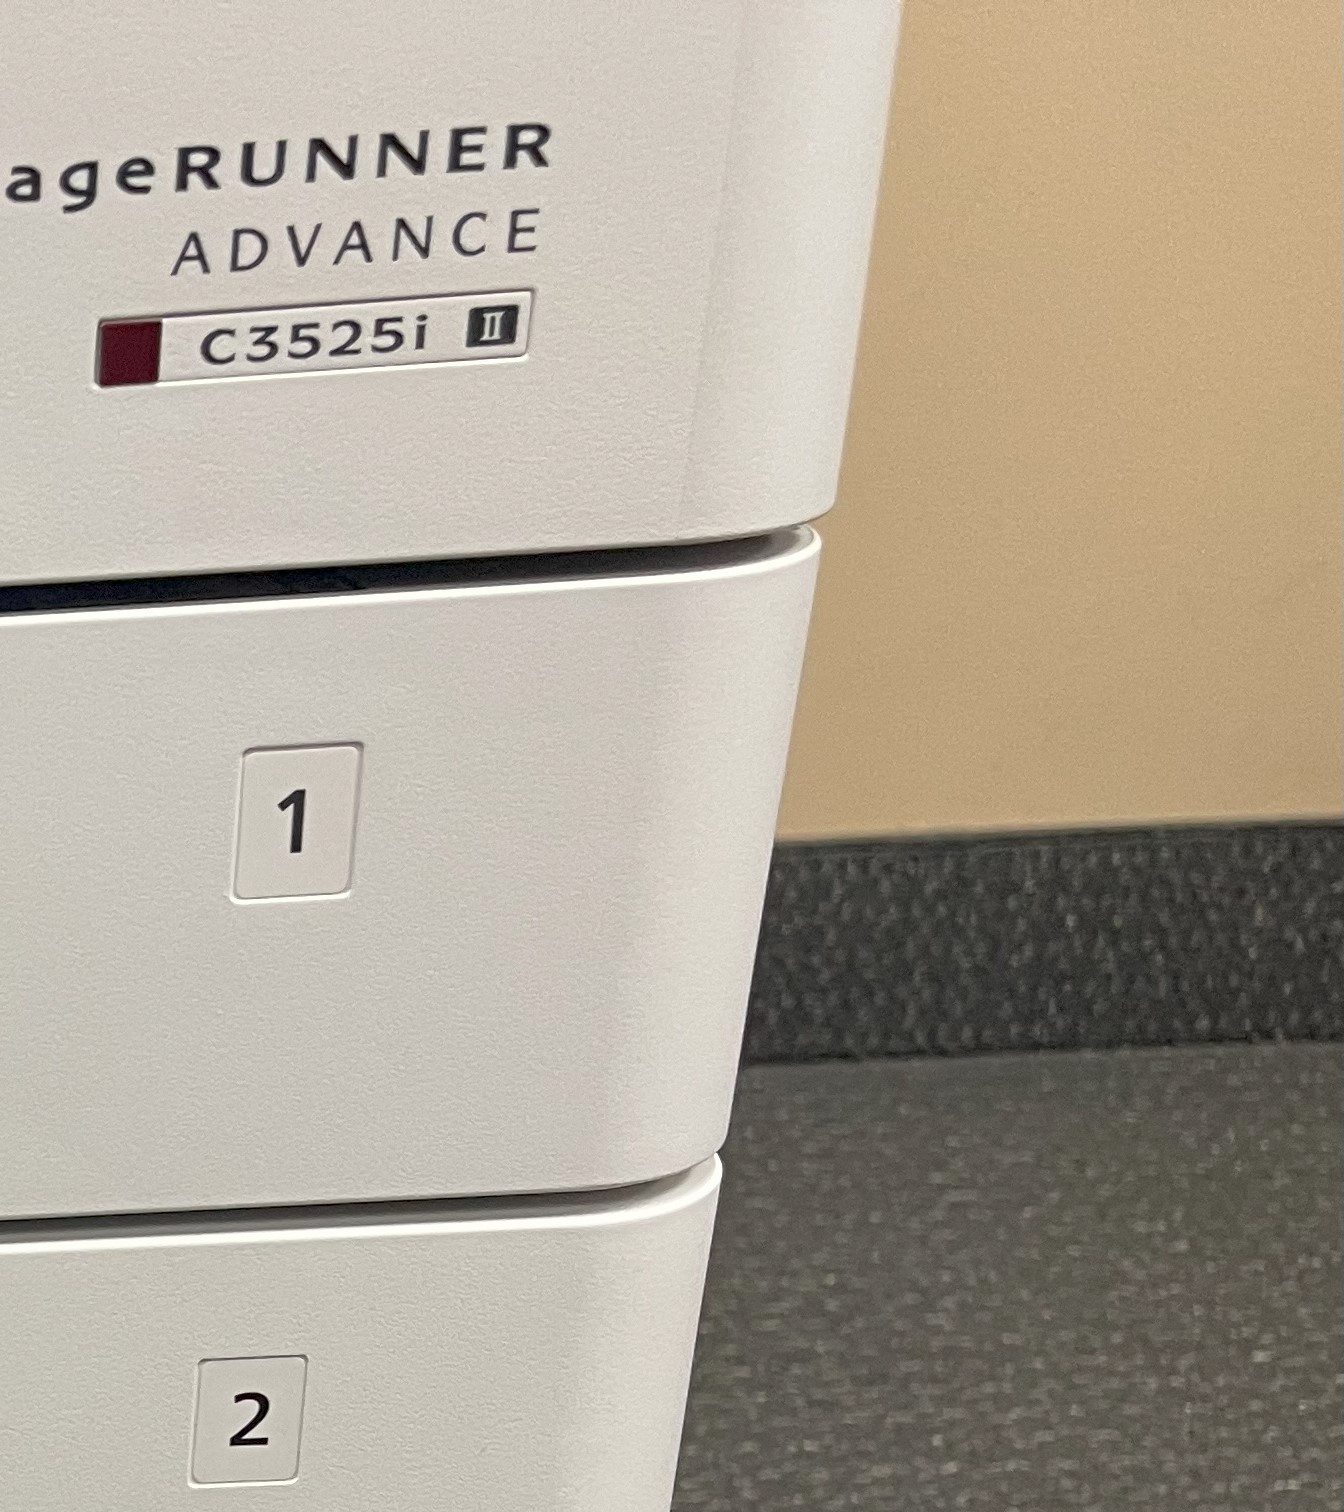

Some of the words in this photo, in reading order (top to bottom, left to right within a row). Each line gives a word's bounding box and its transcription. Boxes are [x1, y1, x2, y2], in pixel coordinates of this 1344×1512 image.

[169, 206, 542, 277] ADVANCE
[199, 313, 430, 366] C3525i
[276, 787, 307, 854] 1
[228, 1390, 271, 1447] 2
